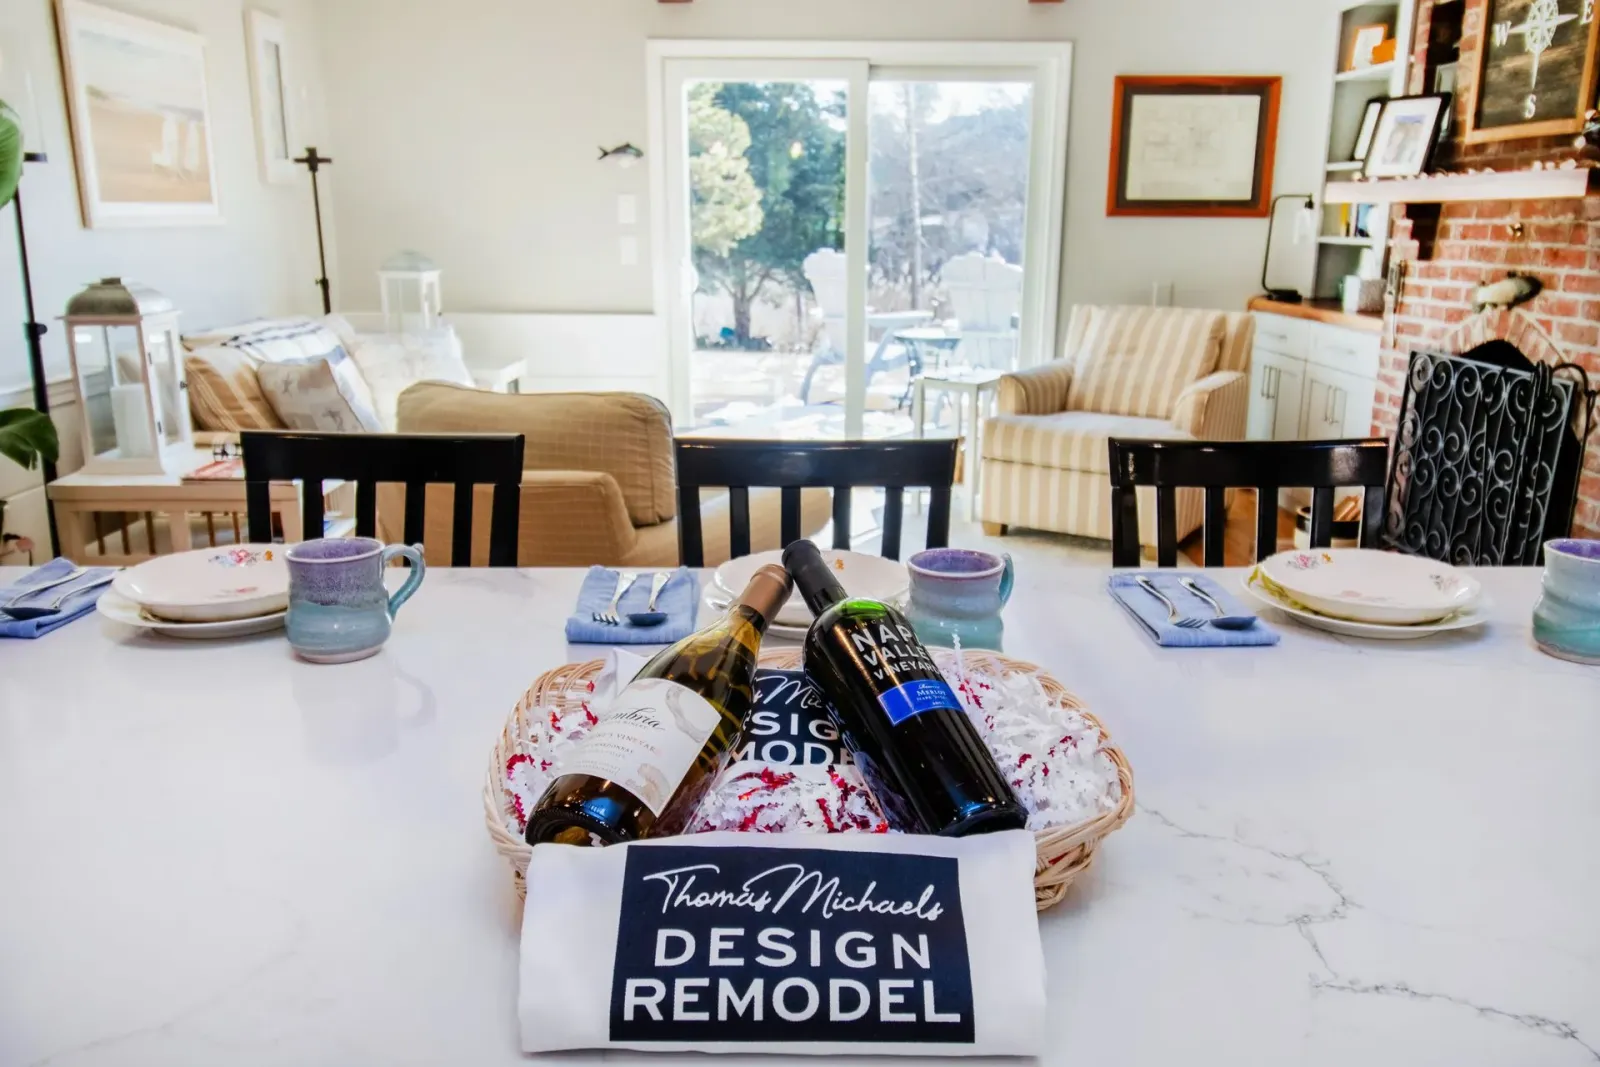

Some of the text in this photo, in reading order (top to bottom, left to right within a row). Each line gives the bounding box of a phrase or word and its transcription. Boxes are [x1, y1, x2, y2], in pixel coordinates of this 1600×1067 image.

[1580, 0, 1594, 25] E
[1493, 20, 1512, 47] W
[1524, 94, 1537, 119] S
[851, 624, 921, 652] NAP
[863, 643, 930, 666] VALLE
[873, 660, 940, 680] VINEYAR
[601, 706, 665, 730] mbria
[748, 710, 839, 740] SIG
[617, 732, 660, 754] VINEYAR
[643, 863, 944, 921] Thomas Michaels
[654, 926, 932, 970] DESIGN
[623, 977, 961, 1023] REMODEL
